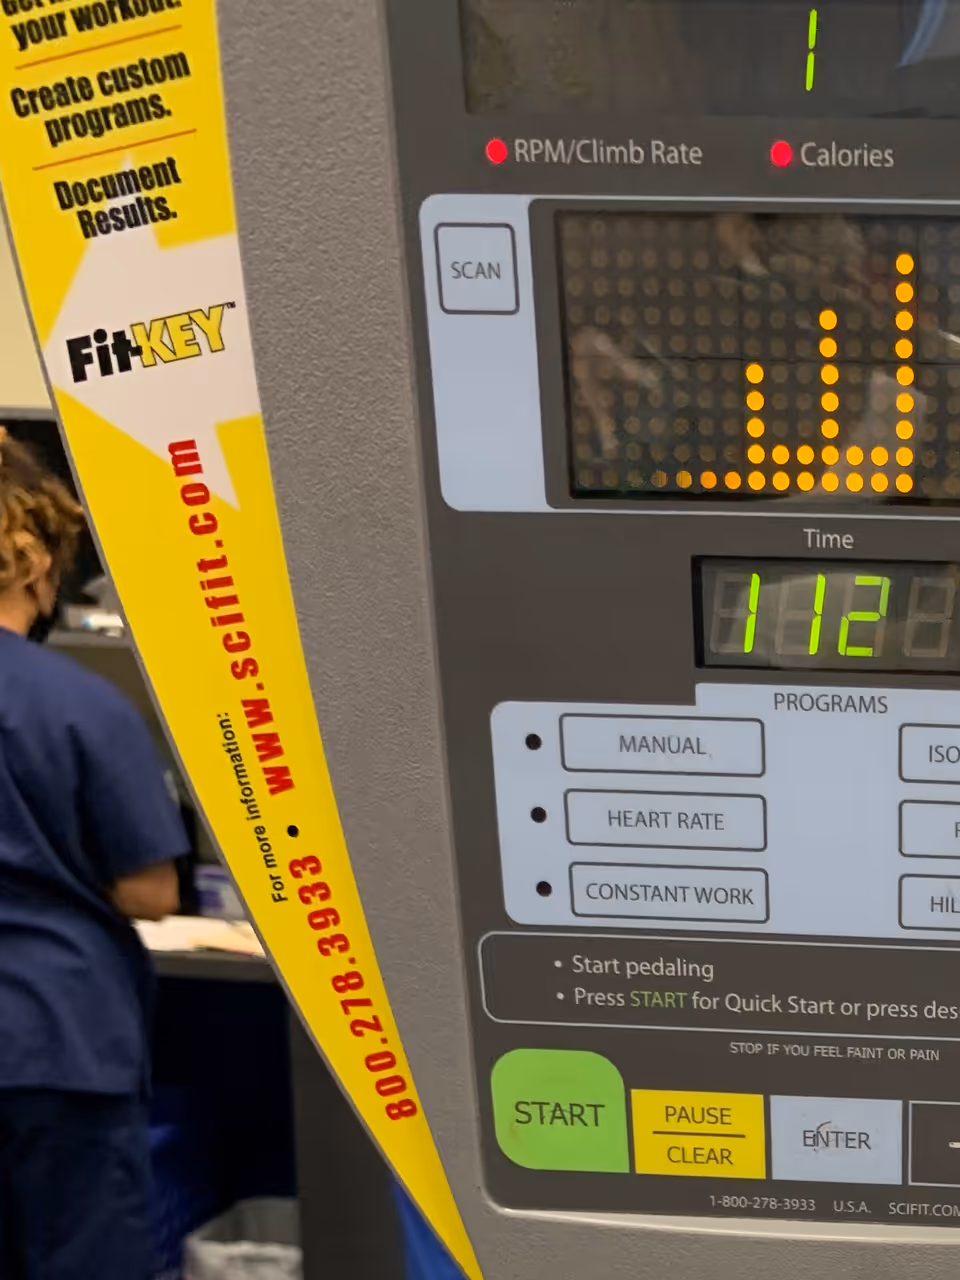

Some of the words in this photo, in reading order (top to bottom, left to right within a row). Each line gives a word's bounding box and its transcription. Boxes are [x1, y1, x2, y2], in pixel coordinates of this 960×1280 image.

[11, 12, 68, 52] your
[10, 75, 95, 118] Create
[97, 51, 191, 97] custom
[44, 93, 172, 147] programs.
[513, 138, 646, 165] RPM/Climb
[651, 140, 703, 165] Rate
[801, 141, 895, 168] Calories
[54, 157, 182, 211] Document
[77, 195, 178, 240] Results.
[450, 260, 502, 280] SCAN
[803, 528, 855, 549] Time
[168, 439, 296, 796] www.scifit.com
[773, 692, 889, 714] PROGRAMS
[619, 735, 707, 755] MANUAL
[216, 712, 262, 821] information:
[607, 809, 672, 829] HEART
[677, 811, 725, 831] RATE
[254, 825, 278, 869] more
[271, 874, 289, 903] For
[586, 883, 690, 903] CONSTANT
[693, 886, 754, 905] WORK
[572, 955, 620, 975] Start
[626, 957, 715, 982] pedaling
[288, 855, 418, 1121] 800.278.3933
[574, 987, 626, 1007] Press
[630, 989, 689, 1009] START
[691, 991, 720, 1010] for
[724, 993, 783, 1013] Quick
[787, 995, 836, 1015] Start
[840, 1001, 862, 1016] or
[866, 1002, 919, 1021] press
[729, 1041, 763, 1055] STOP
[767, 1043, 780, 1055] IF
[783, 1044, 810, 1056] YOU
[813, 1045, 844, 1058] FEEL
[846, 1047, 884, 1059] FAINT
[887, 1048, 906, 1060] OR
[910, 1049, 940, 1061] PAIN
[514, 1100, 605, 1128] START
[664, 1105, 733, 1126] PAUSE
[802, 1129, 872, 1151] ENTER
[667, 1145, 734, 1166] CLEAR
[709, 1195, 816, 1211] 1-800-278-3933
[833, 1199, 872, 1214] U.S.A.
